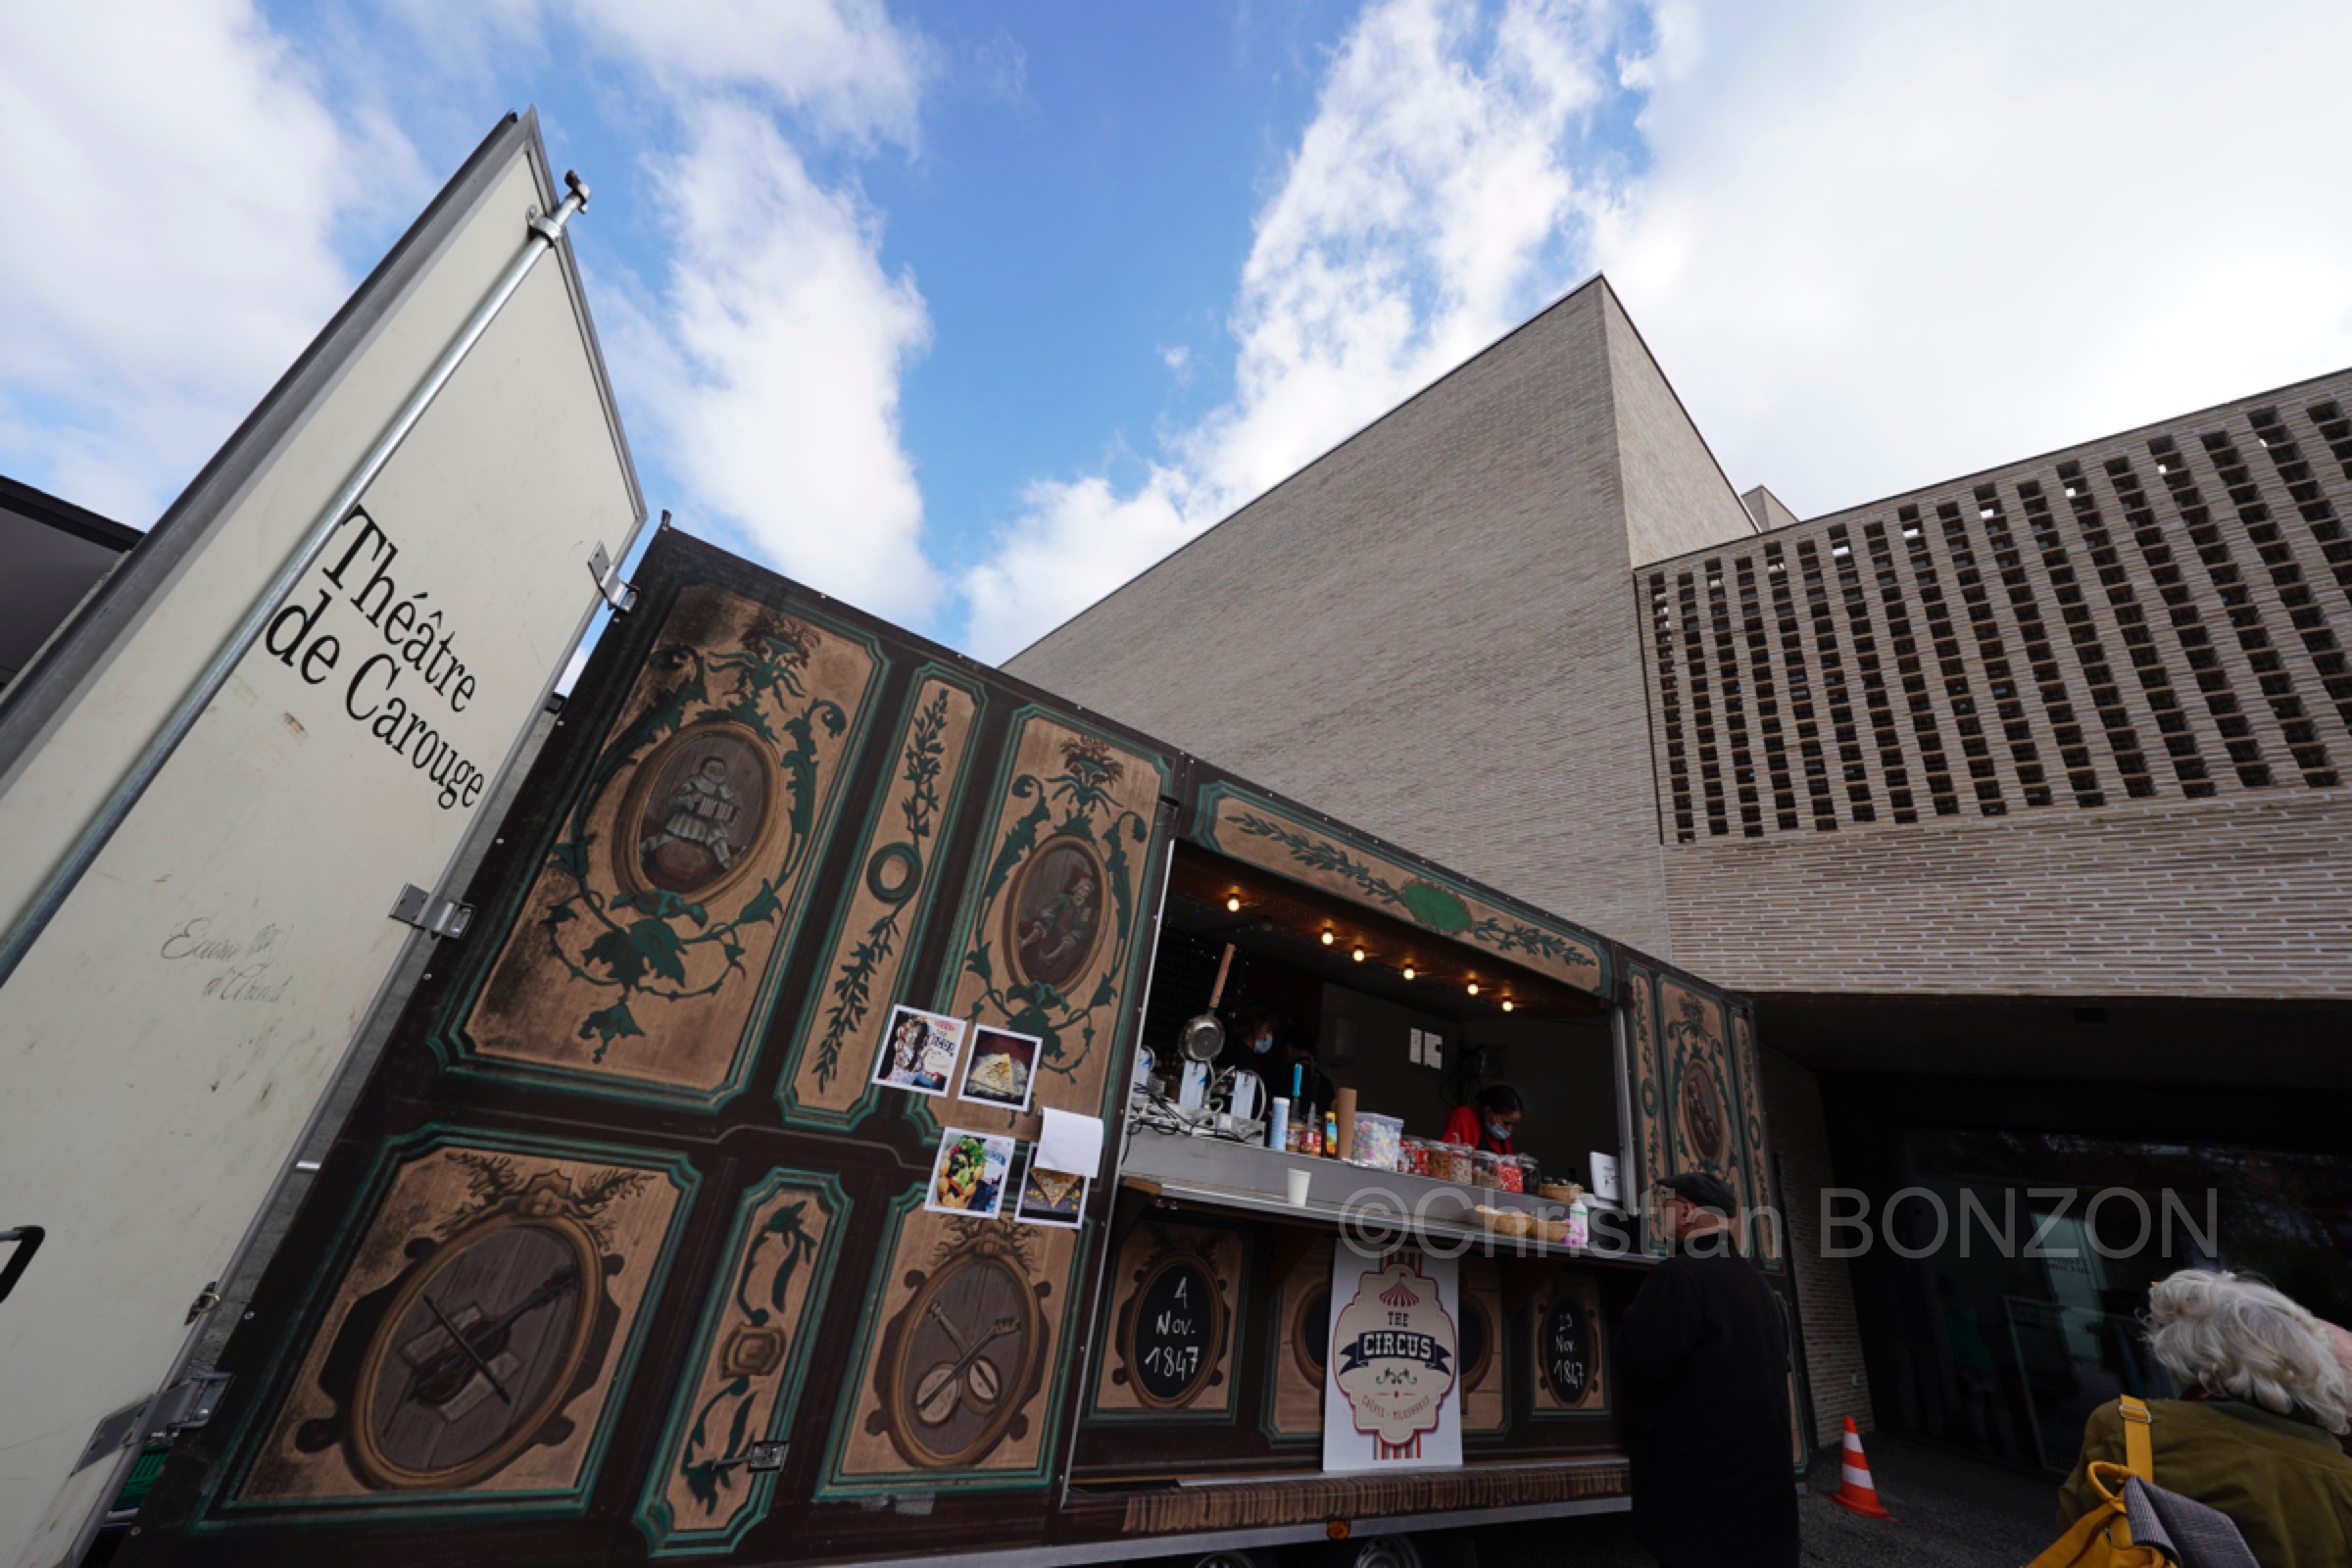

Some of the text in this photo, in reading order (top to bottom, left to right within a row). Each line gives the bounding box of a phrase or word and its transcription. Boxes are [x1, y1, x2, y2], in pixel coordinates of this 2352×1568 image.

[322, 504, 476, 712] Théâtre
[266, 588, 484, 809] de Carouge
[1155, 1310, 1196, 1336] Nov.
[1388, 1311, 1409, 1327] THE
[1363, 1333, 1432, 1359] CIRCUS
[1144, 1347, 1200, 1382] 1847
